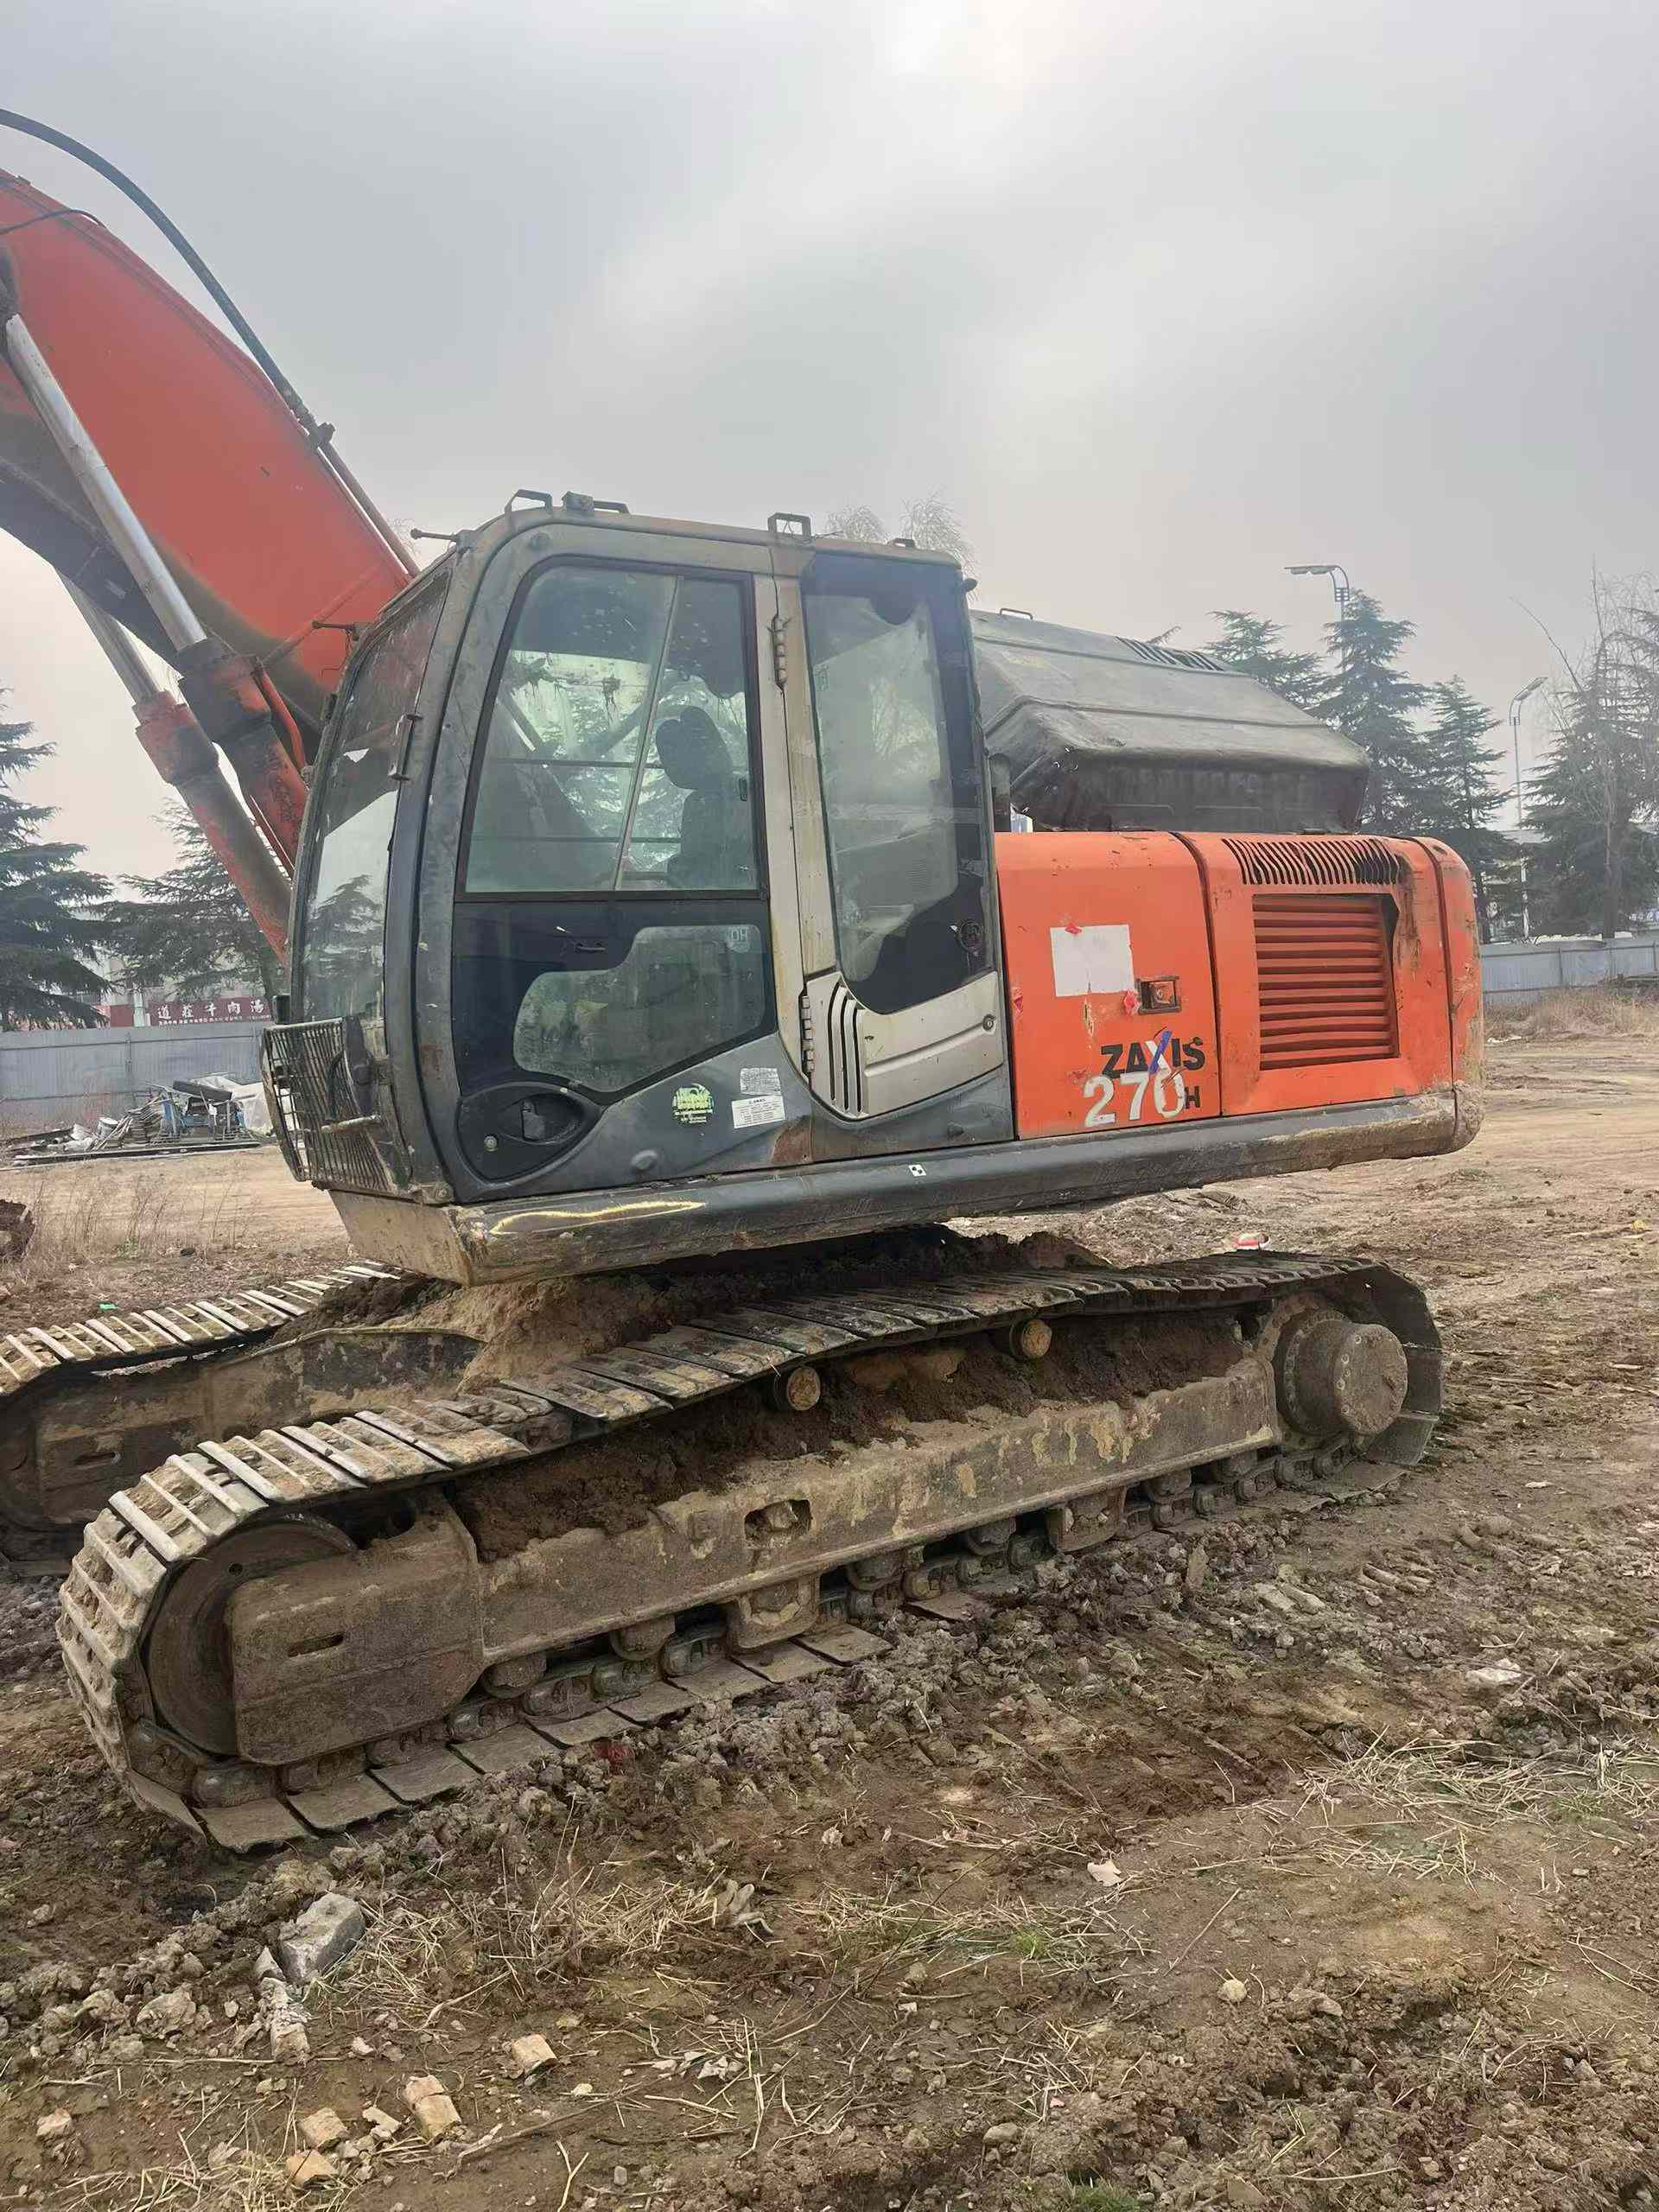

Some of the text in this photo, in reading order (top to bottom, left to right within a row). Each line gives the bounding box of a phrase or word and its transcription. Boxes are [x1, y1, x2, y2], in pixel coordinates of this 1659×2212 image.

[1100, 1032, 1206, 1079] ZAXIS
[1083, 1071, 1201, 1127] 270 H
